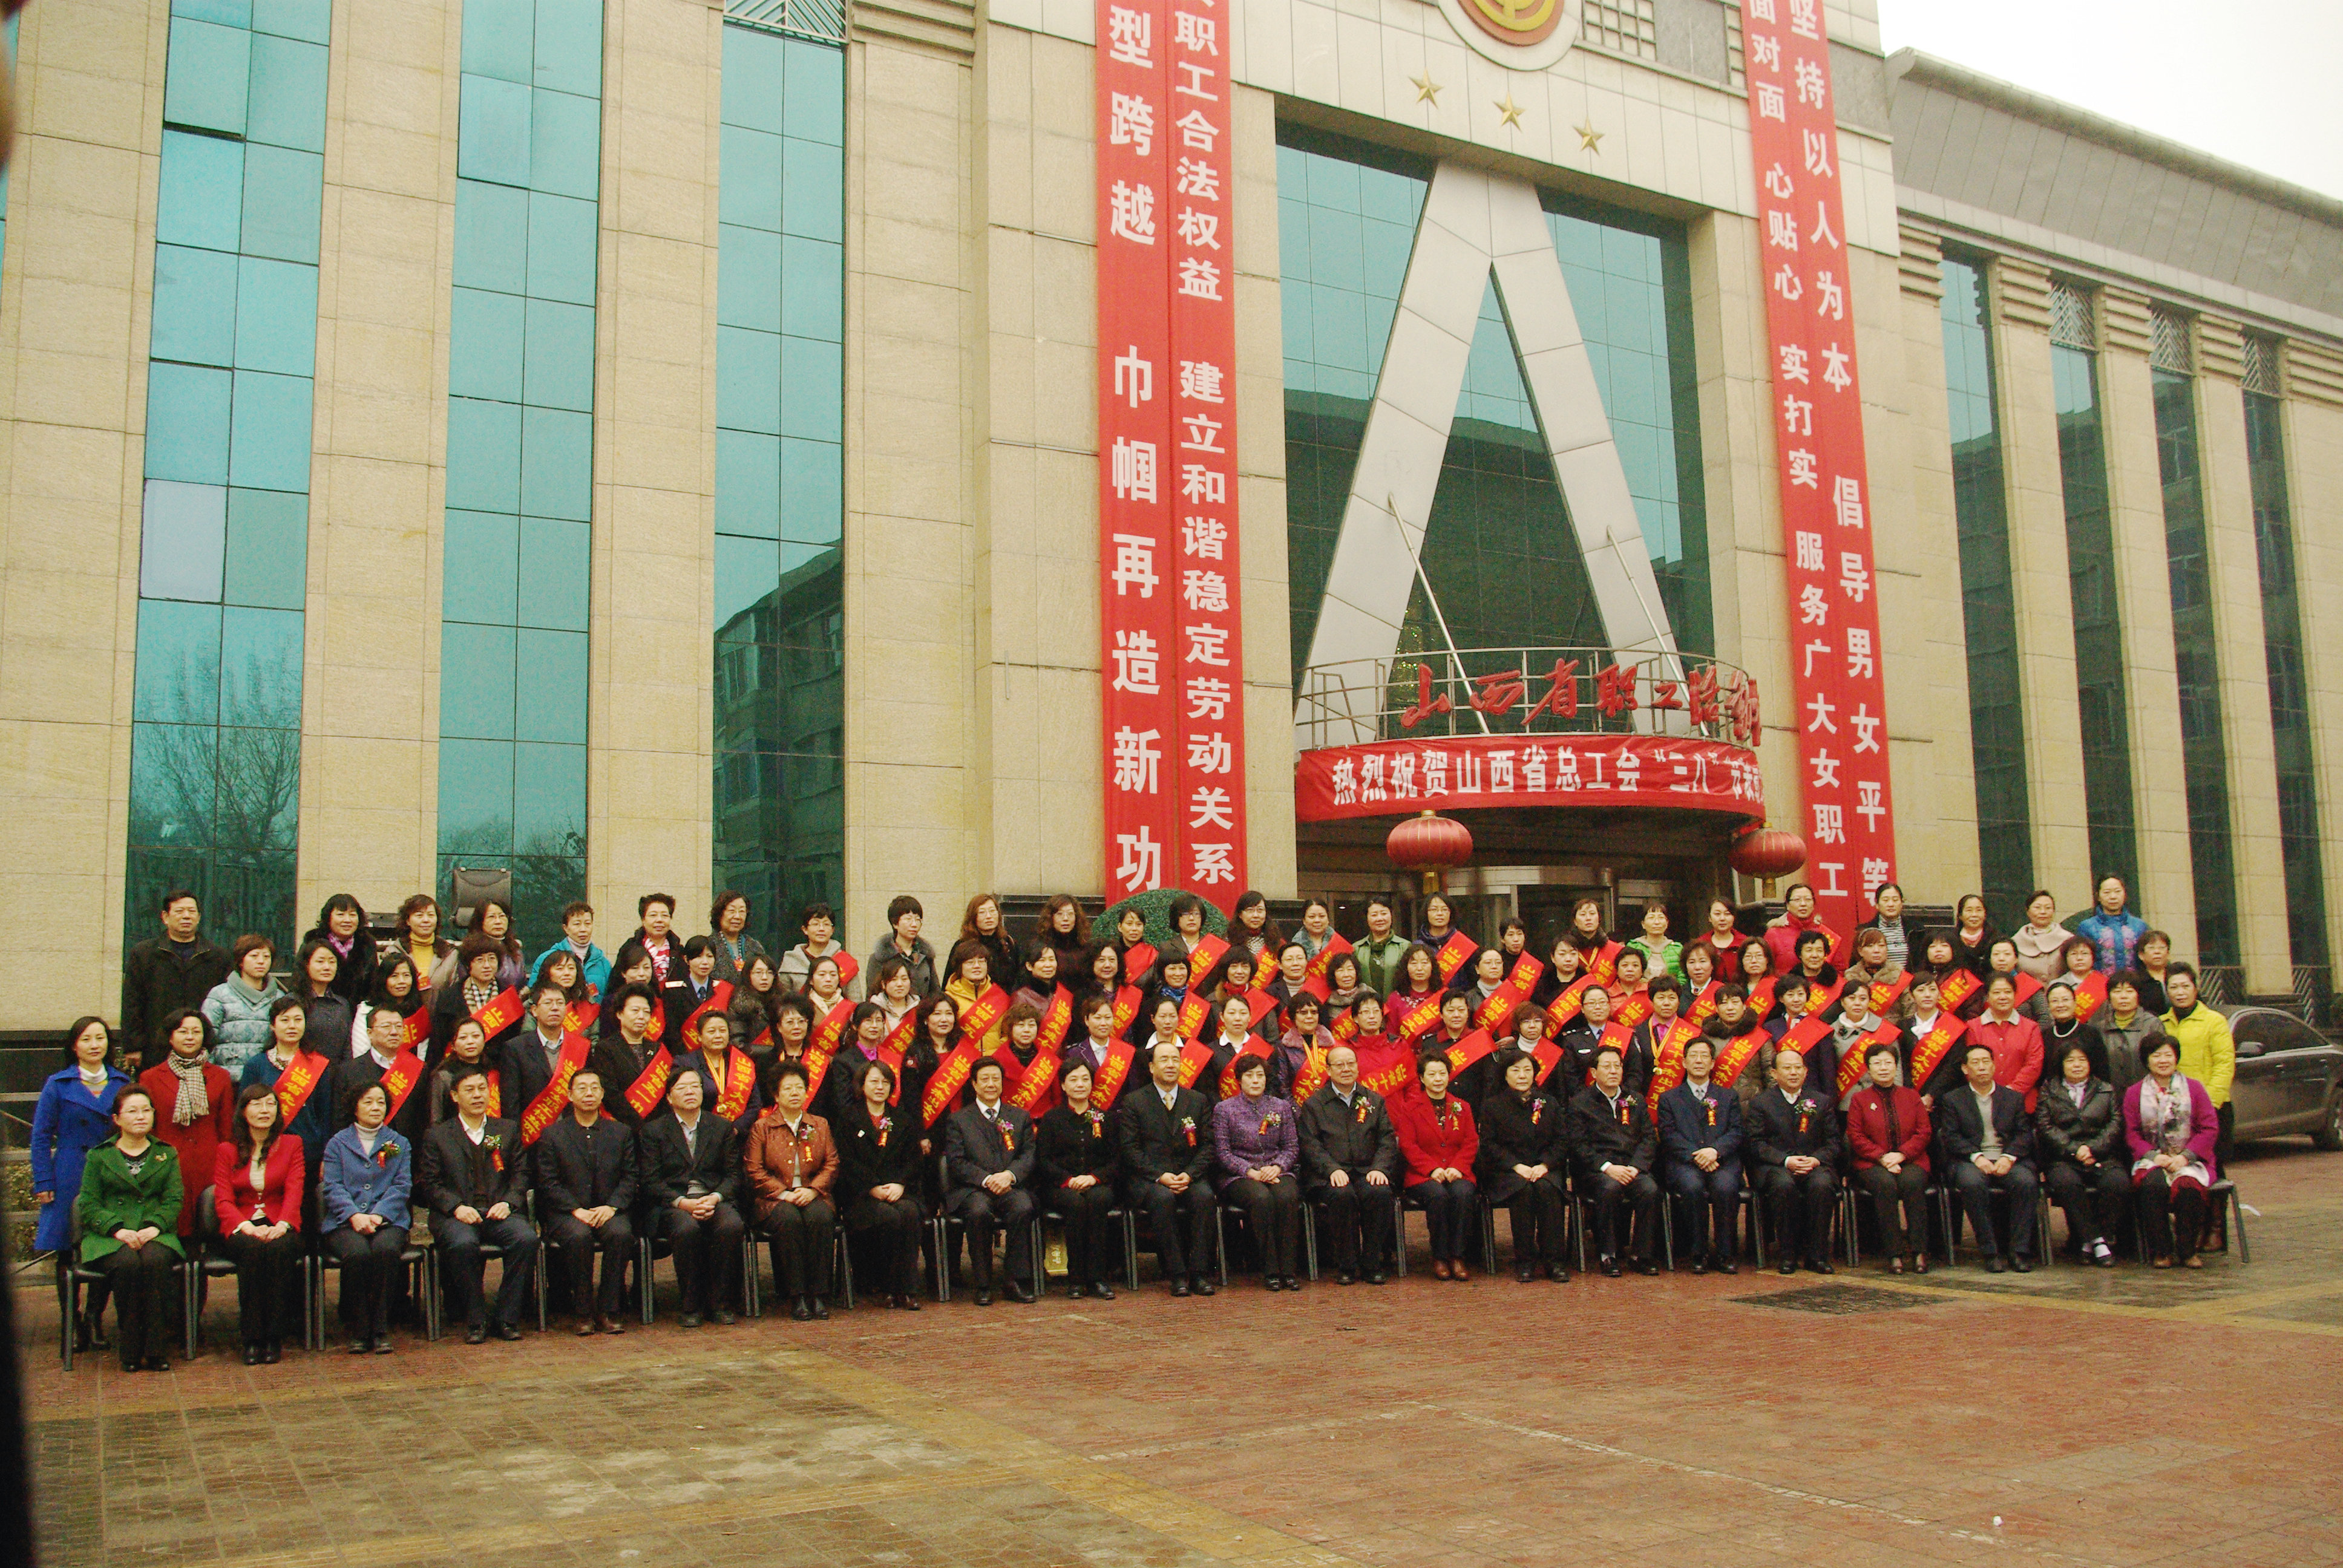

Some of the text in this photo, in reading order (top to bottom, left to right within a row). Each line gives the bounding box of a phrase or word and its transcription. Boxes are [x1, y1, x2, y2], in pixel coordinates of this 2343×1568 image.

[1765, 162, 1803, 301] 心贴心
[1780, 343, 1818, 490] 实打实
[1109, 5, 1161, 892] 型跨越 巾帼再造新功
[1175, 0, 1235, 884] 职工合法权益 建立和谐稳定劳动关系
[1789, 0, 1889, 906] 坚持以人为本 倡导男女平等
[1796, 530, 1848, 897] 服务广大女职工
[1190, 949, 1212, 982] 山西省
[1437, 946, 1462, 981] 山西省
[1512, 964, 1536, 994] 山西省
[1802, 988, 1828, 1012] 山西省
[888, 1023, 916, 1052] 山西省
[1110, 1002, 1132, 1038] 山西省
[1448, 1049, 1468, 1071] 山西
